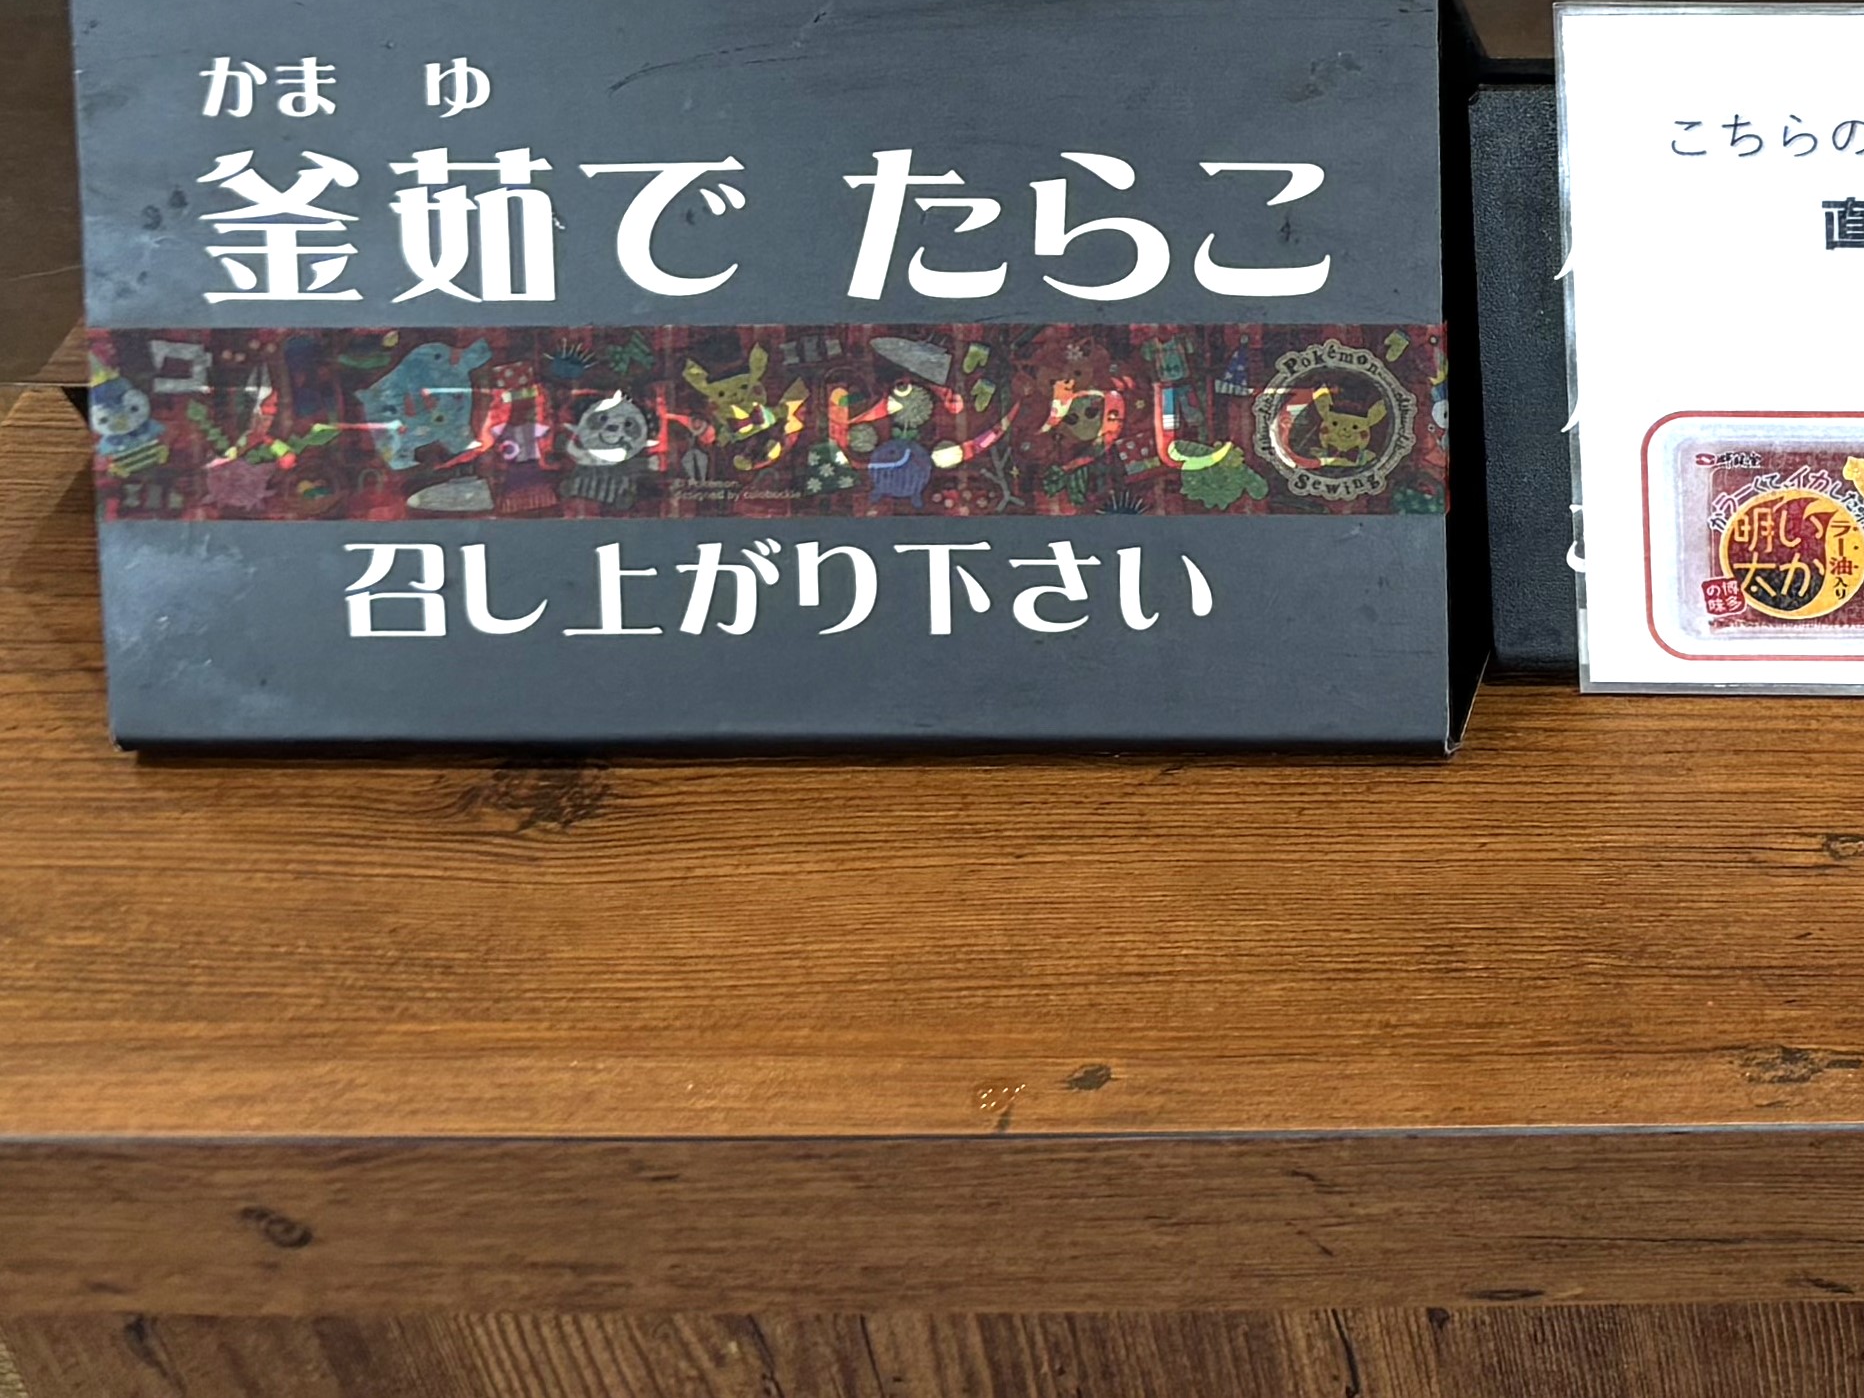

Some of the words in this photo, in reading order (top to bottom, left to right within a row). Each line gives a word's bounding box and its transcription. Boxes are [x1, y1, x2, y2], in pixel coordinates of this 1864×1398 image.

[200, 57, 338, 119] かま
[426, 58, 492, 119] ゆ
[197, 148, 747, 305] 釜茹で
[844, 149, 1332, 302] たらこ
[1293, 473, 1382, 497] Sewing
[345, 539, 1214, 638] 召し上がり下さい
